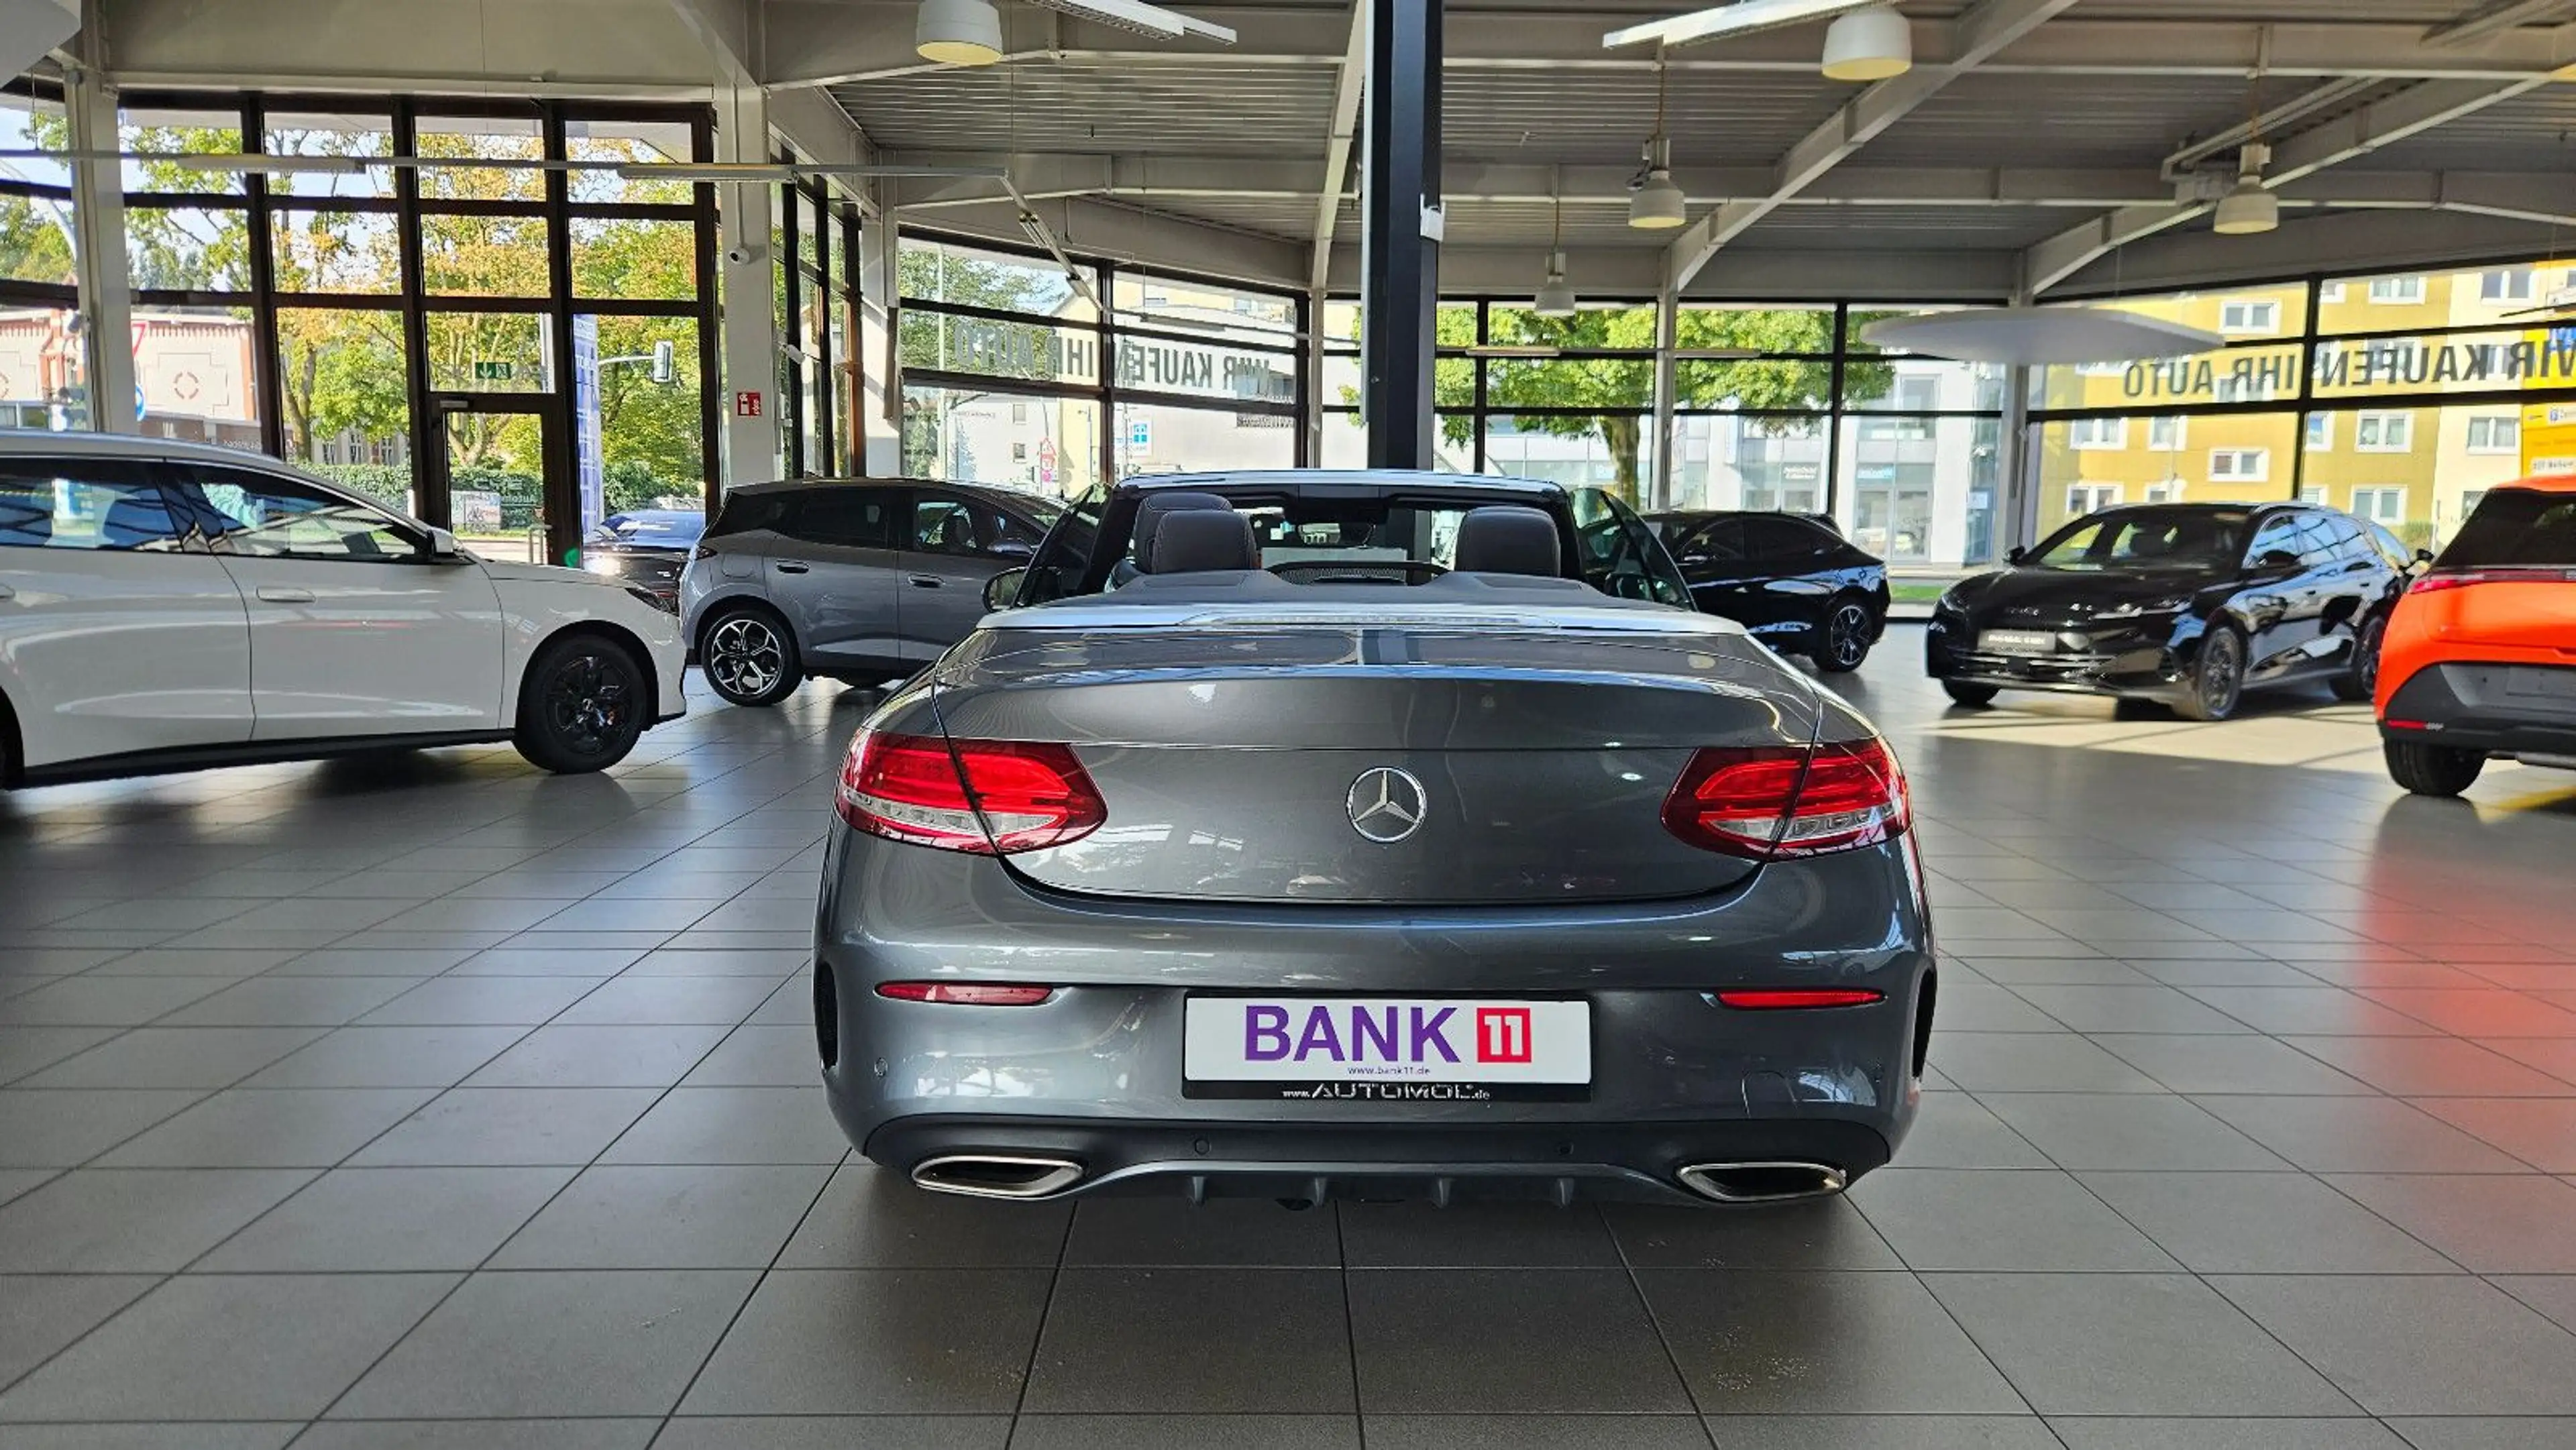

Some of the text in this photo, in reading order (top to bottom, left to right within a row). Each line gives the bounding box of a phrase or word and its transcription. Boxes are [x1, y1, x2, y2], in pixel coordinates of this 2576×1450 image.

[1246, 1005, 1524, 1063] BANK 11
[1347, 1066, 1431, 1076] www.bank11.de
